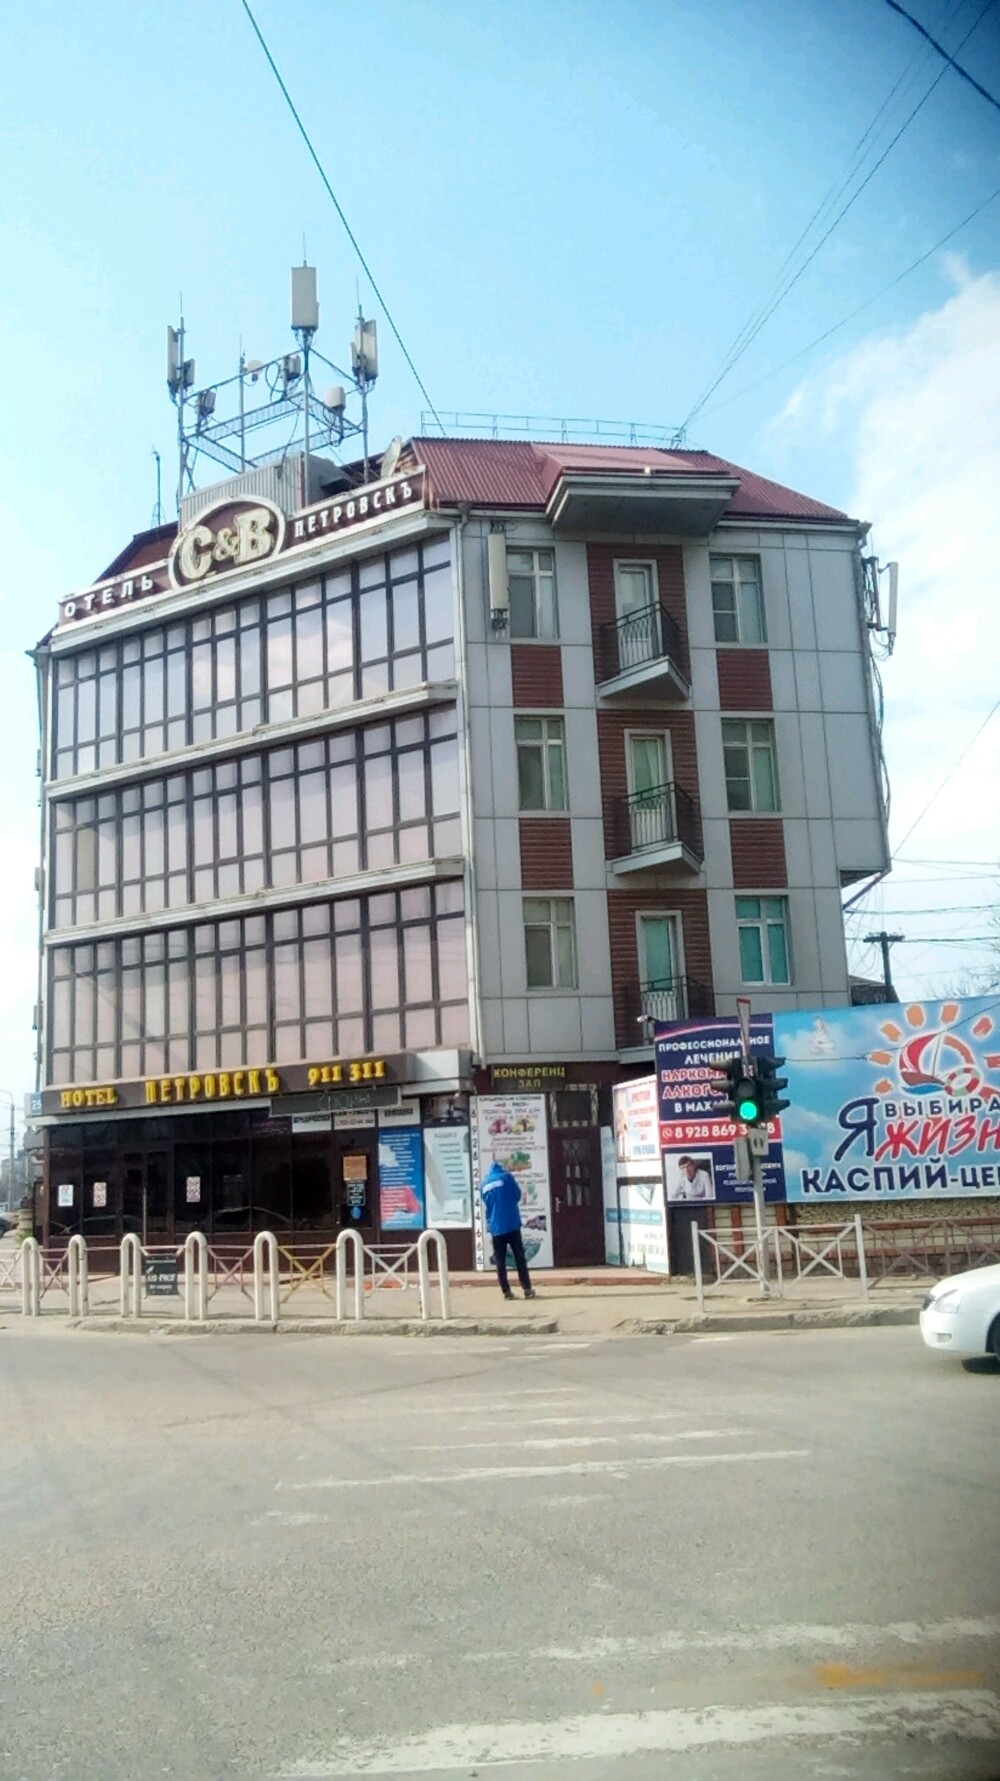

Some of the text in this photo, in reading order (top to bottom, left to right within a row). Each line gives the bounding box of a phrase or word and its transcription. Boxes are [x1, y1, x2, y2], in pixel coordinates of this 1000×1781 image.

[64, 481, 413, 617] ОТЕЛЬ C&B ПЕТРОВСКЪ
[658, 1036, 770, 1052] ПРОФЕССИОНАЛНОЕ
[684, 1051, 741, 1065] ЛЕЧЕНИЕ
[493, 1066, 566, 1078] КОНФЕРЕНЦ
[60, 1060, 386, 1109] HOTEL ПЕТРОВСКЪ 911 311
[518, 1079, 541, 1089] ЗАЛ
[675, 1127, 683, 1138] 8
[686, 1126, 709, 1138] 928
[712, 1124, 736, 1136] 869
[834, 1097, 880, 1161] Я
[802, 1157, 1000, 1193] КАСПИЙ-ЦЕ
